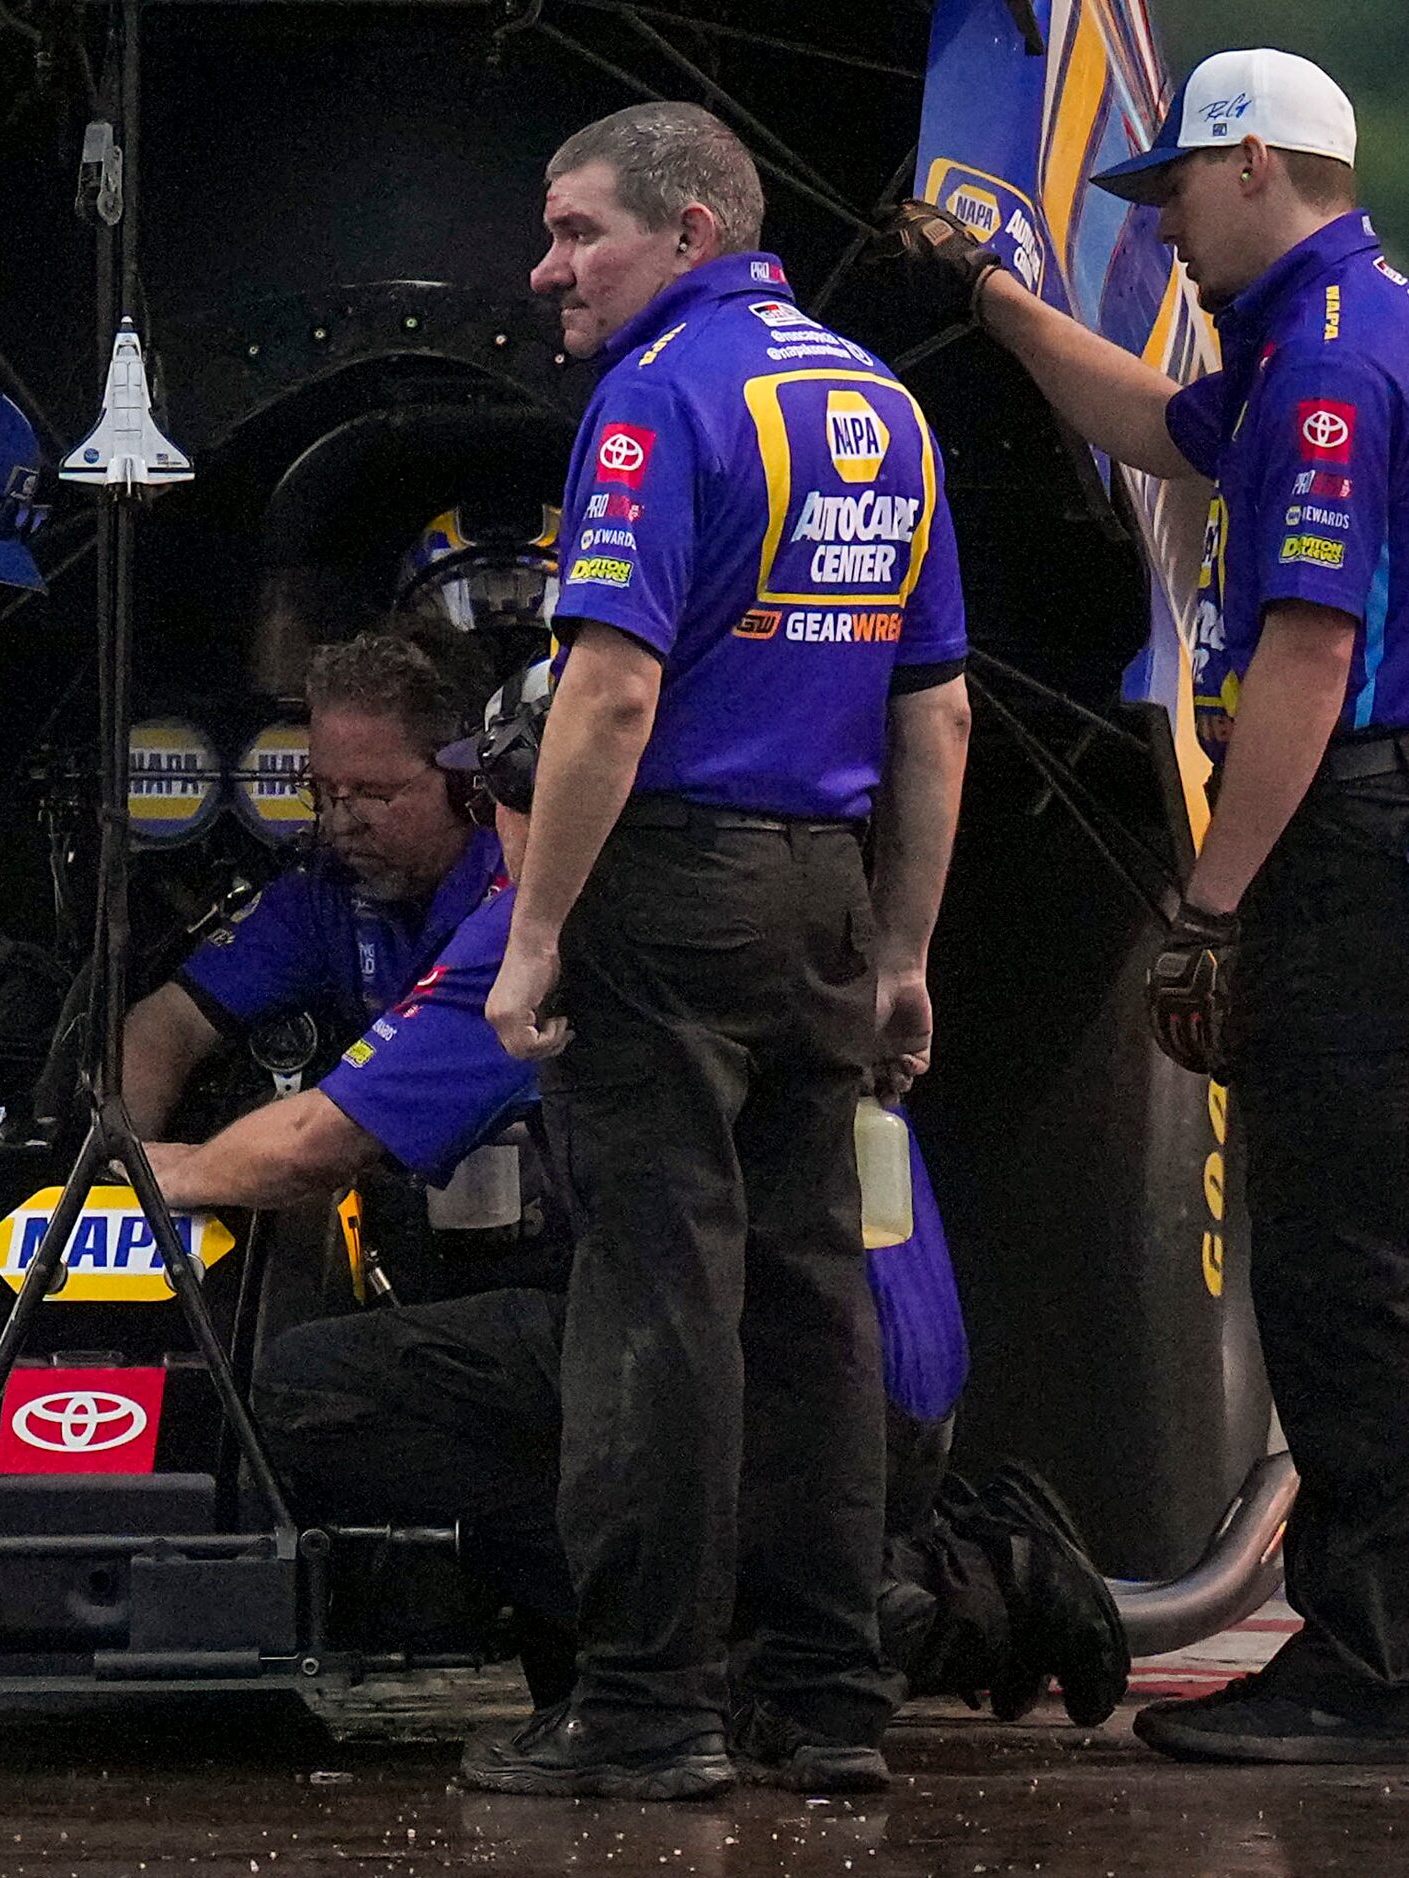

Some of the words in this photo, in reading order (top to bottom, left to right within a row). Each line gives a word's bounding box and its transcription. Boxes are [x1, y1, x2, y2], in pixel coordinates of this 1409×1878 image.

[955, 195, 994, 231] NAPA
[832, 417, 879, 454] NAPA
[810, 545, 896, 583] CENTER
